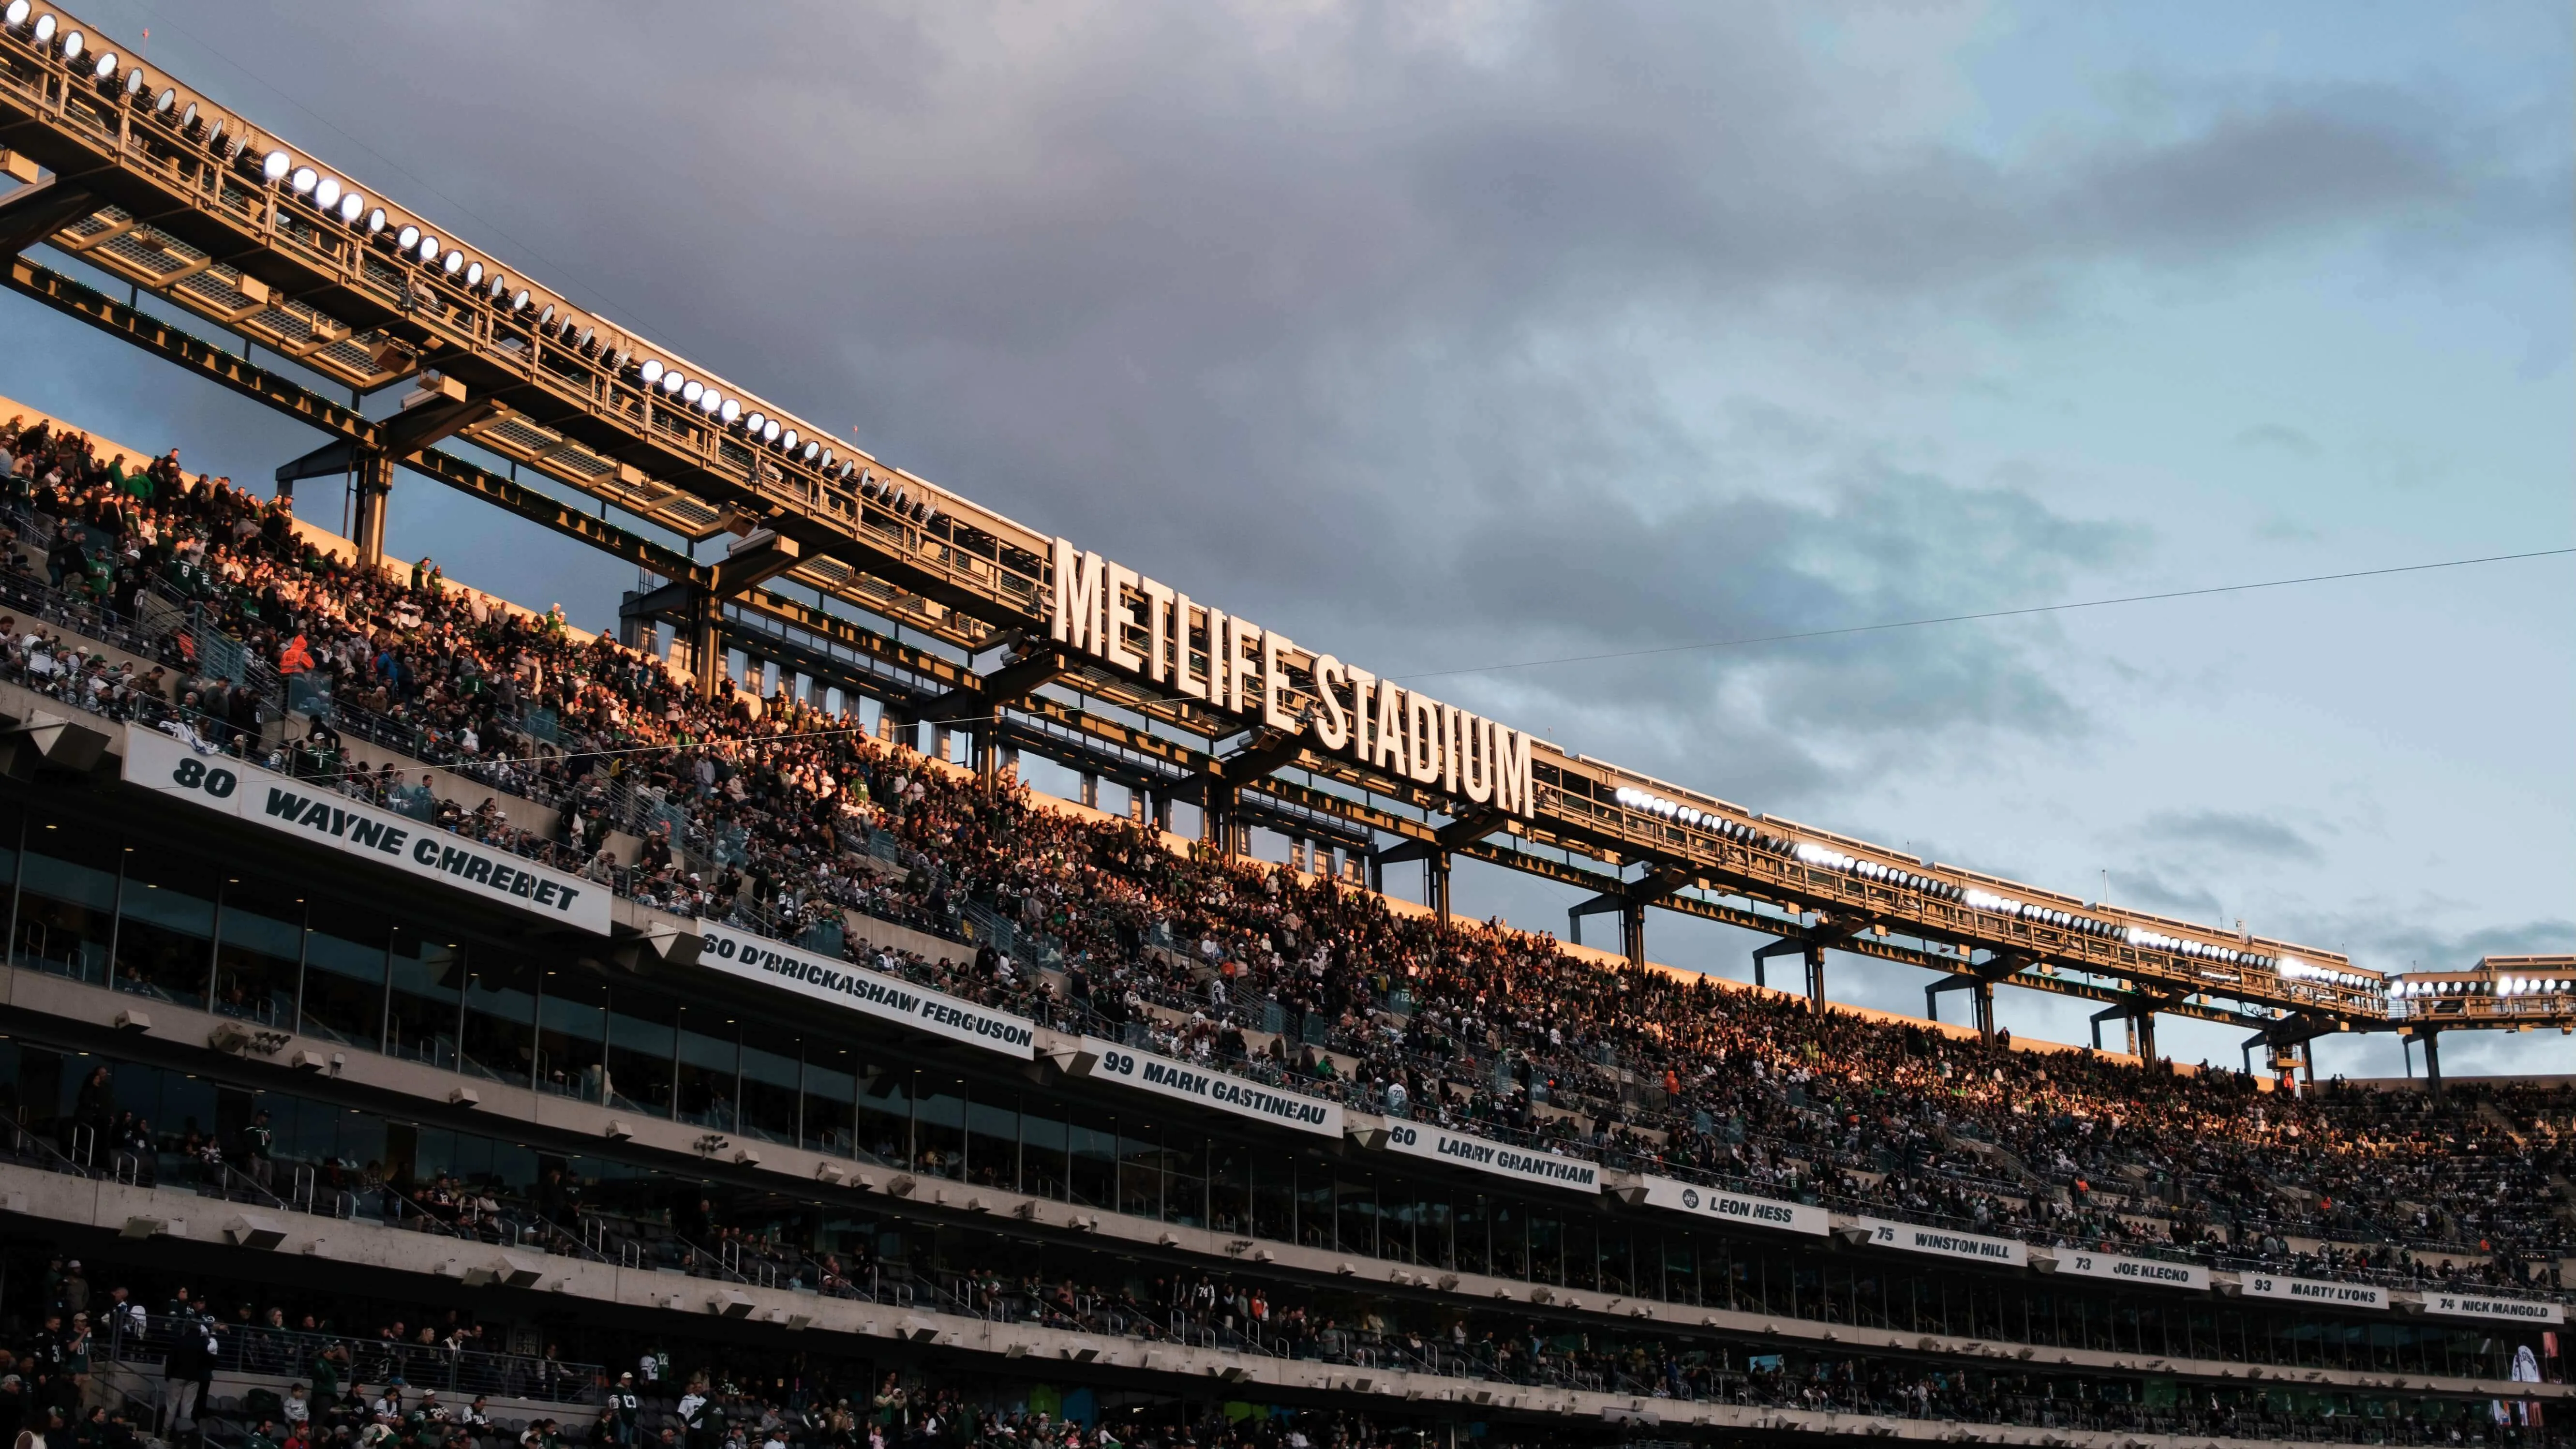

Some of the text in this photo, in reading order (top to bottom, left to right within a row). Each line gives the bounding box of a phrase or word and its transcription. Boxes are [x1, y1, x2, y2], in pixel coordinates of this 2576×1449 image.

[182, 565, 190, 577] 8
[1052, 536, 1534, 819] METLIFE STADIUM
[173, 758, 580, 911] 80 WAYNE CHREBET
[702, 933, 1033, 1047] 60 D'BRICKASHAW FERGUSON
[1400, 992, 1410, 1002] 12
[1103, 1051, 1326, 1125] 99 MARK GASTINEAU
[1393, 1090, 1402, 1099] 20
[1391, 1126, 1594, 1184] 60 LARRY GRANTHAM
[1709, 1196, 1792, 1223] LEON HESS
[1877, 1226, 2009, 1258] 75 WINSTON HILL
[2075, 1257, 2189, 1282] 73 JOE KLECKO
[1198, 1286, 1208, 1298] 74
[2254, 1279, 2376, 1302] 93 MARTY LYONS
[2440, 1299, 2548, 1317] 74 NICK MANGOLD
